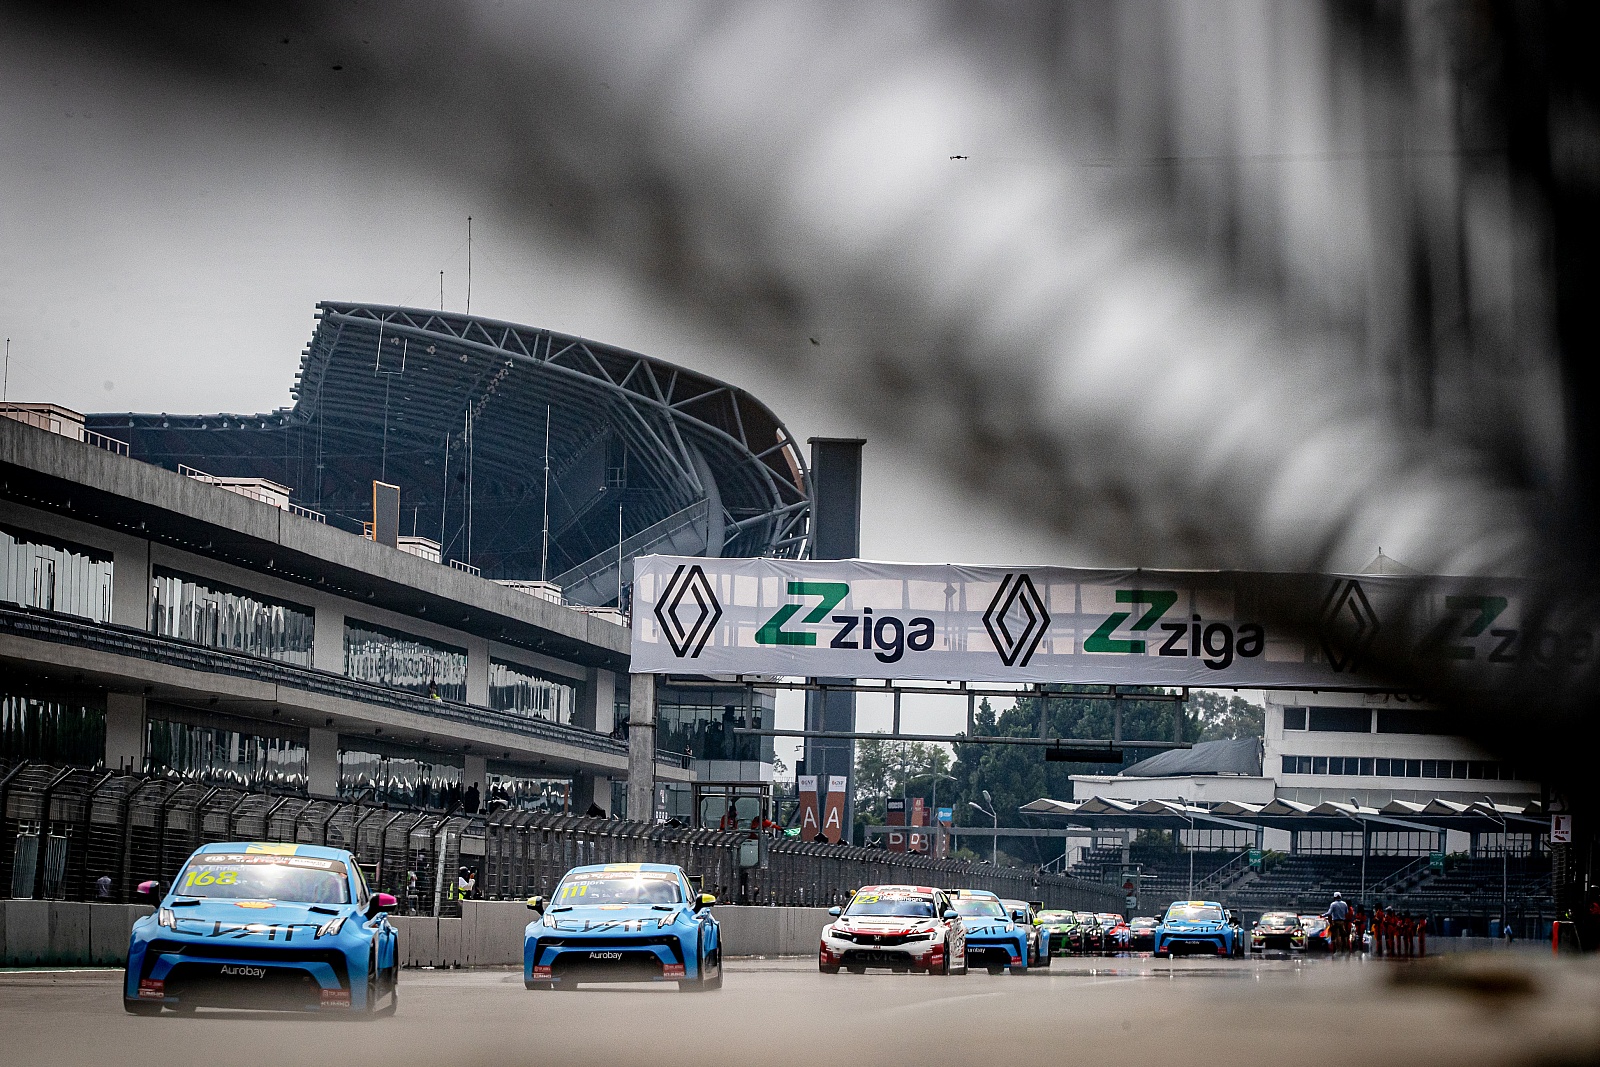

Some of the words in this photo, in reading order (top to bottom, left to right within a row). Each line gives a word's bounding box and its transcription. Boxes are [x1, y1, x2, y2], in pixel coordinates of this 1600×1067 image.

[829, 606, 935, 664] ziga
[1158, 613, 1265, 671] ziga
[803, 806, 817, 828] A
[825, 806, 840, 829] A
[185, 870, 239, 887] 168
[561, 885, 589, 899] 111
[853, 895, 880, 905] 123
[588, 951, 623, 961] Aurobay
[220, 964, 267, 979] Aurobay
